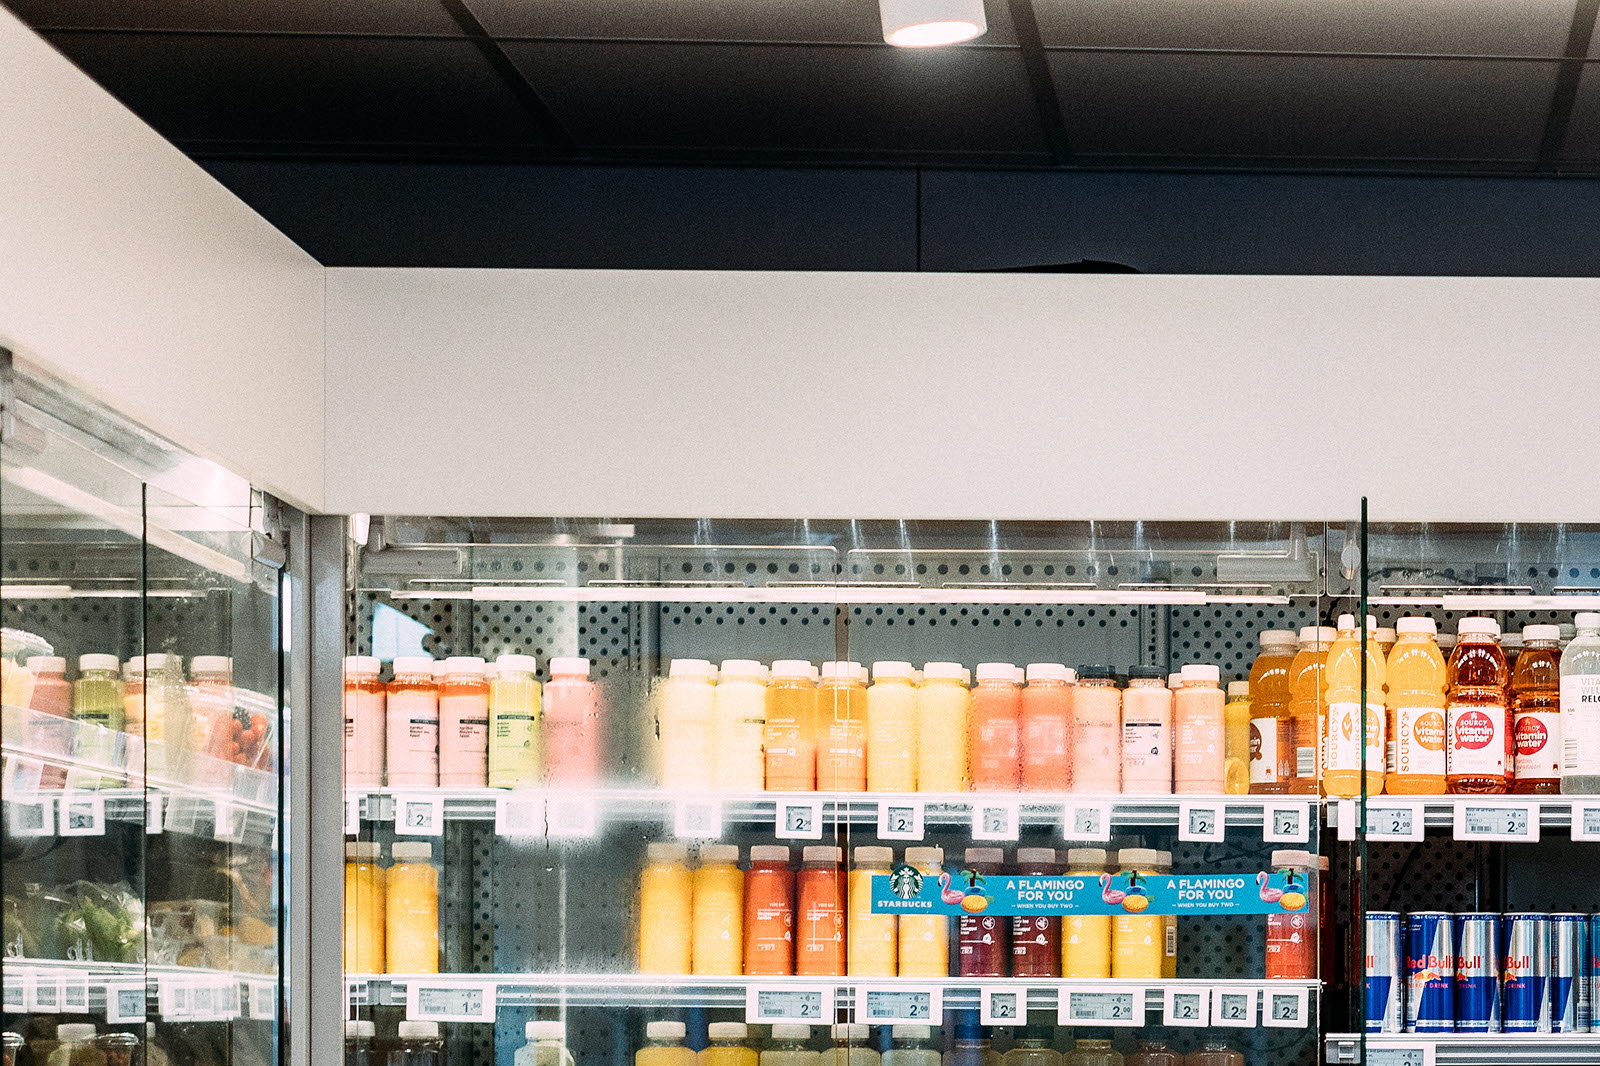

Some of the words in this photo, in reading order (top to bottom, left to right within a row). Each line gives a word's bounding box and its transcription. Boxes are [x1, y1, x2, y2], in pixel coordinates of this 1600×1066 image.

[1392, 820, 1410, 833] 2.00
[1507, 820, 1526, 833] 2.00
[1006, 880, 1016, 890] A
[1018, 880, 1084, 890] FLAMINGO
[1167, 880, 1176, 889] A
[1179, 879, 1245, 889] FLAMINGO
[1018, 891, 1039, 901] FOR
[1046, 891, 1073, 901] YOU
[1178, 890, 1200, 900] FOR
[1207, 889, 1233, 900] YOU
[877, 900, 933, 909] STARBUCKS
[1428, 955, 1451, 969] Bull
[1507, 956, 1530, 969] Bull
[1112, 1005, 1131, 1018] 2.00
